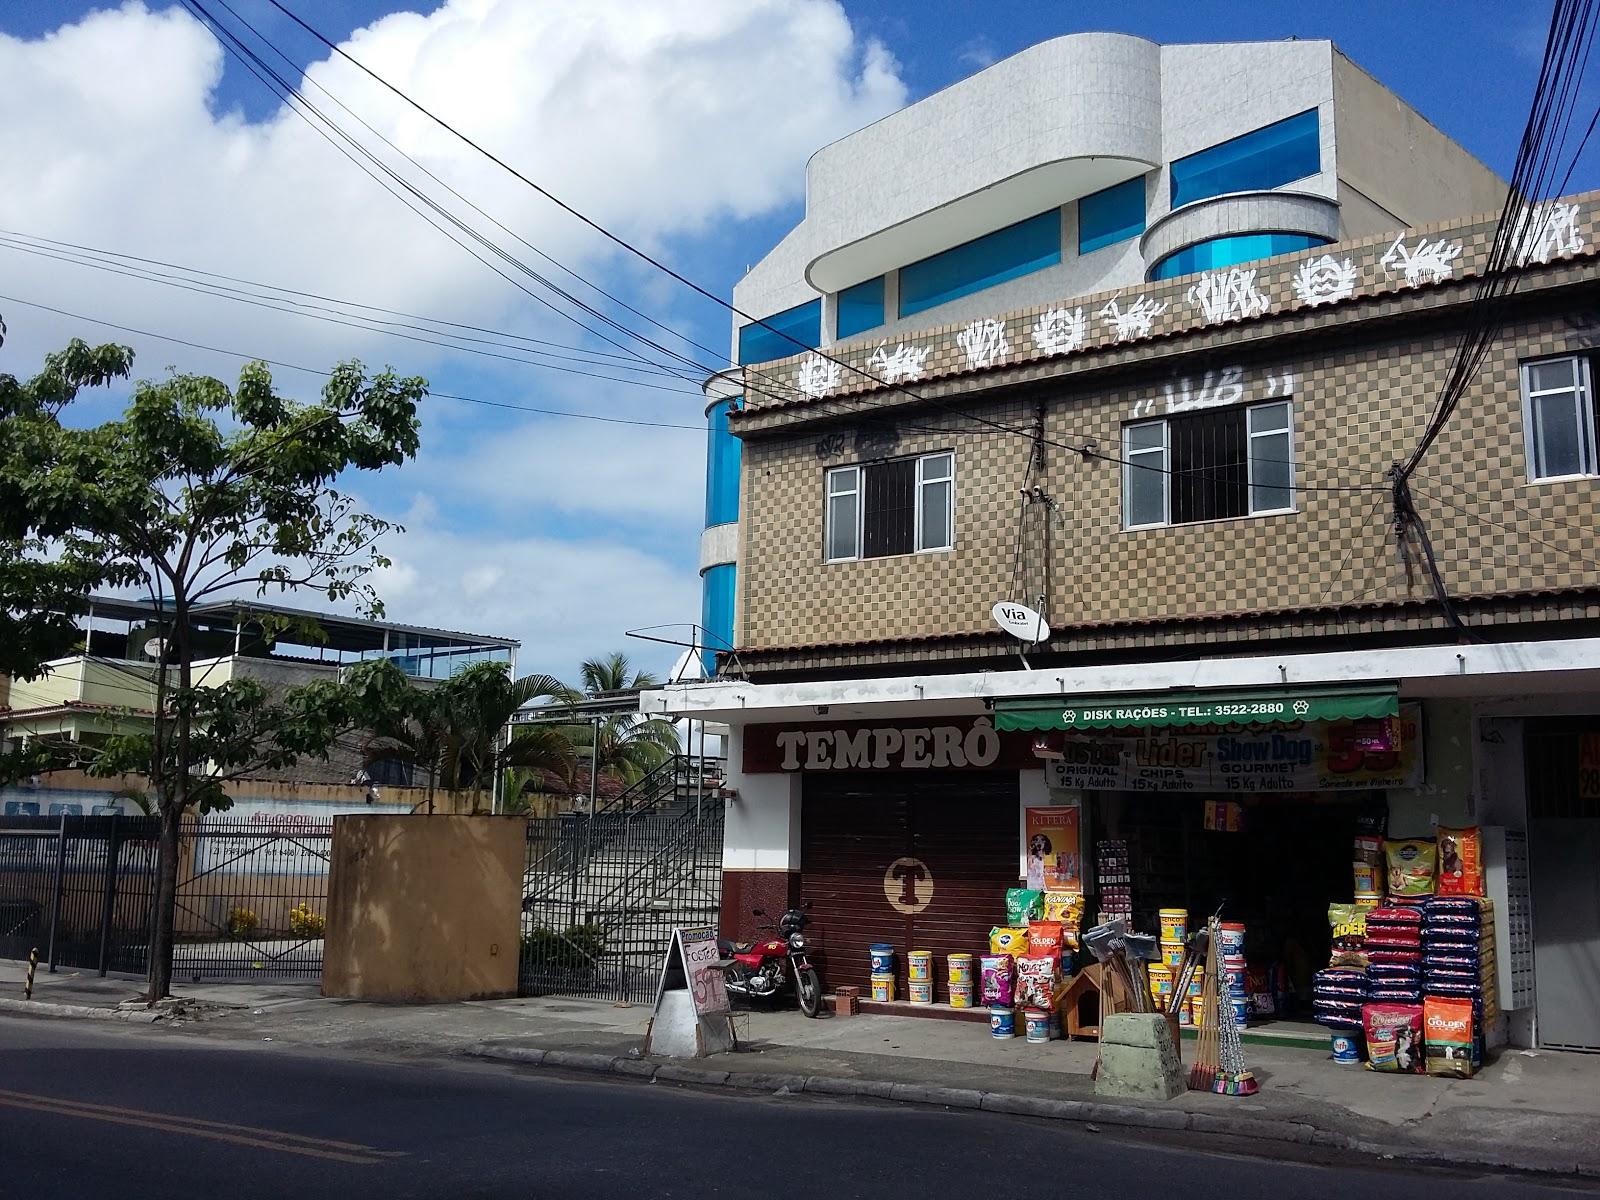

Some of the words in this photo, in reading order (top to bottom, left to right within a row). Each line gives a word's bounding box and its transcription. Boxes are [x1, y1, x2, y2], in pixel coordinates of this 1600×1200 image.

[1001, 607, 1026, 620] Via
[1083, 710, 1112, 720] DISK
[1116, 707, 1168, 720] RAÇÕES
[1178, 706, 1211, 717] TEL.:
[1214, 703, 1284, 716] 3522-2880
[776, 716, 1001, 770] TEMPERÔ
[1217, 734, 1270, 761] Show
[1271, 735, 1312, 765] Dog
[1055, 765, 1118, 776] ORIGINAL
[1220, 762, 1297, 773] GOURMET
[1140, 769, 1185, 779] CHIPS
[1060, 776, 1072, 786] 15
[1075, 777, 1085, 788] Kg
[1087, 776, 1116, 788] Adulto
[1132, 779, 1146, 790] 15
[1161, 779, 1194, 790] Adulto
[1225, 777, 1240, 789] 15
[1243, 777, 1255, 791] Kg
[1260, 776, 1295, 790] Adulto
[1427, 1017, 1467, 1029] GOLDEN
